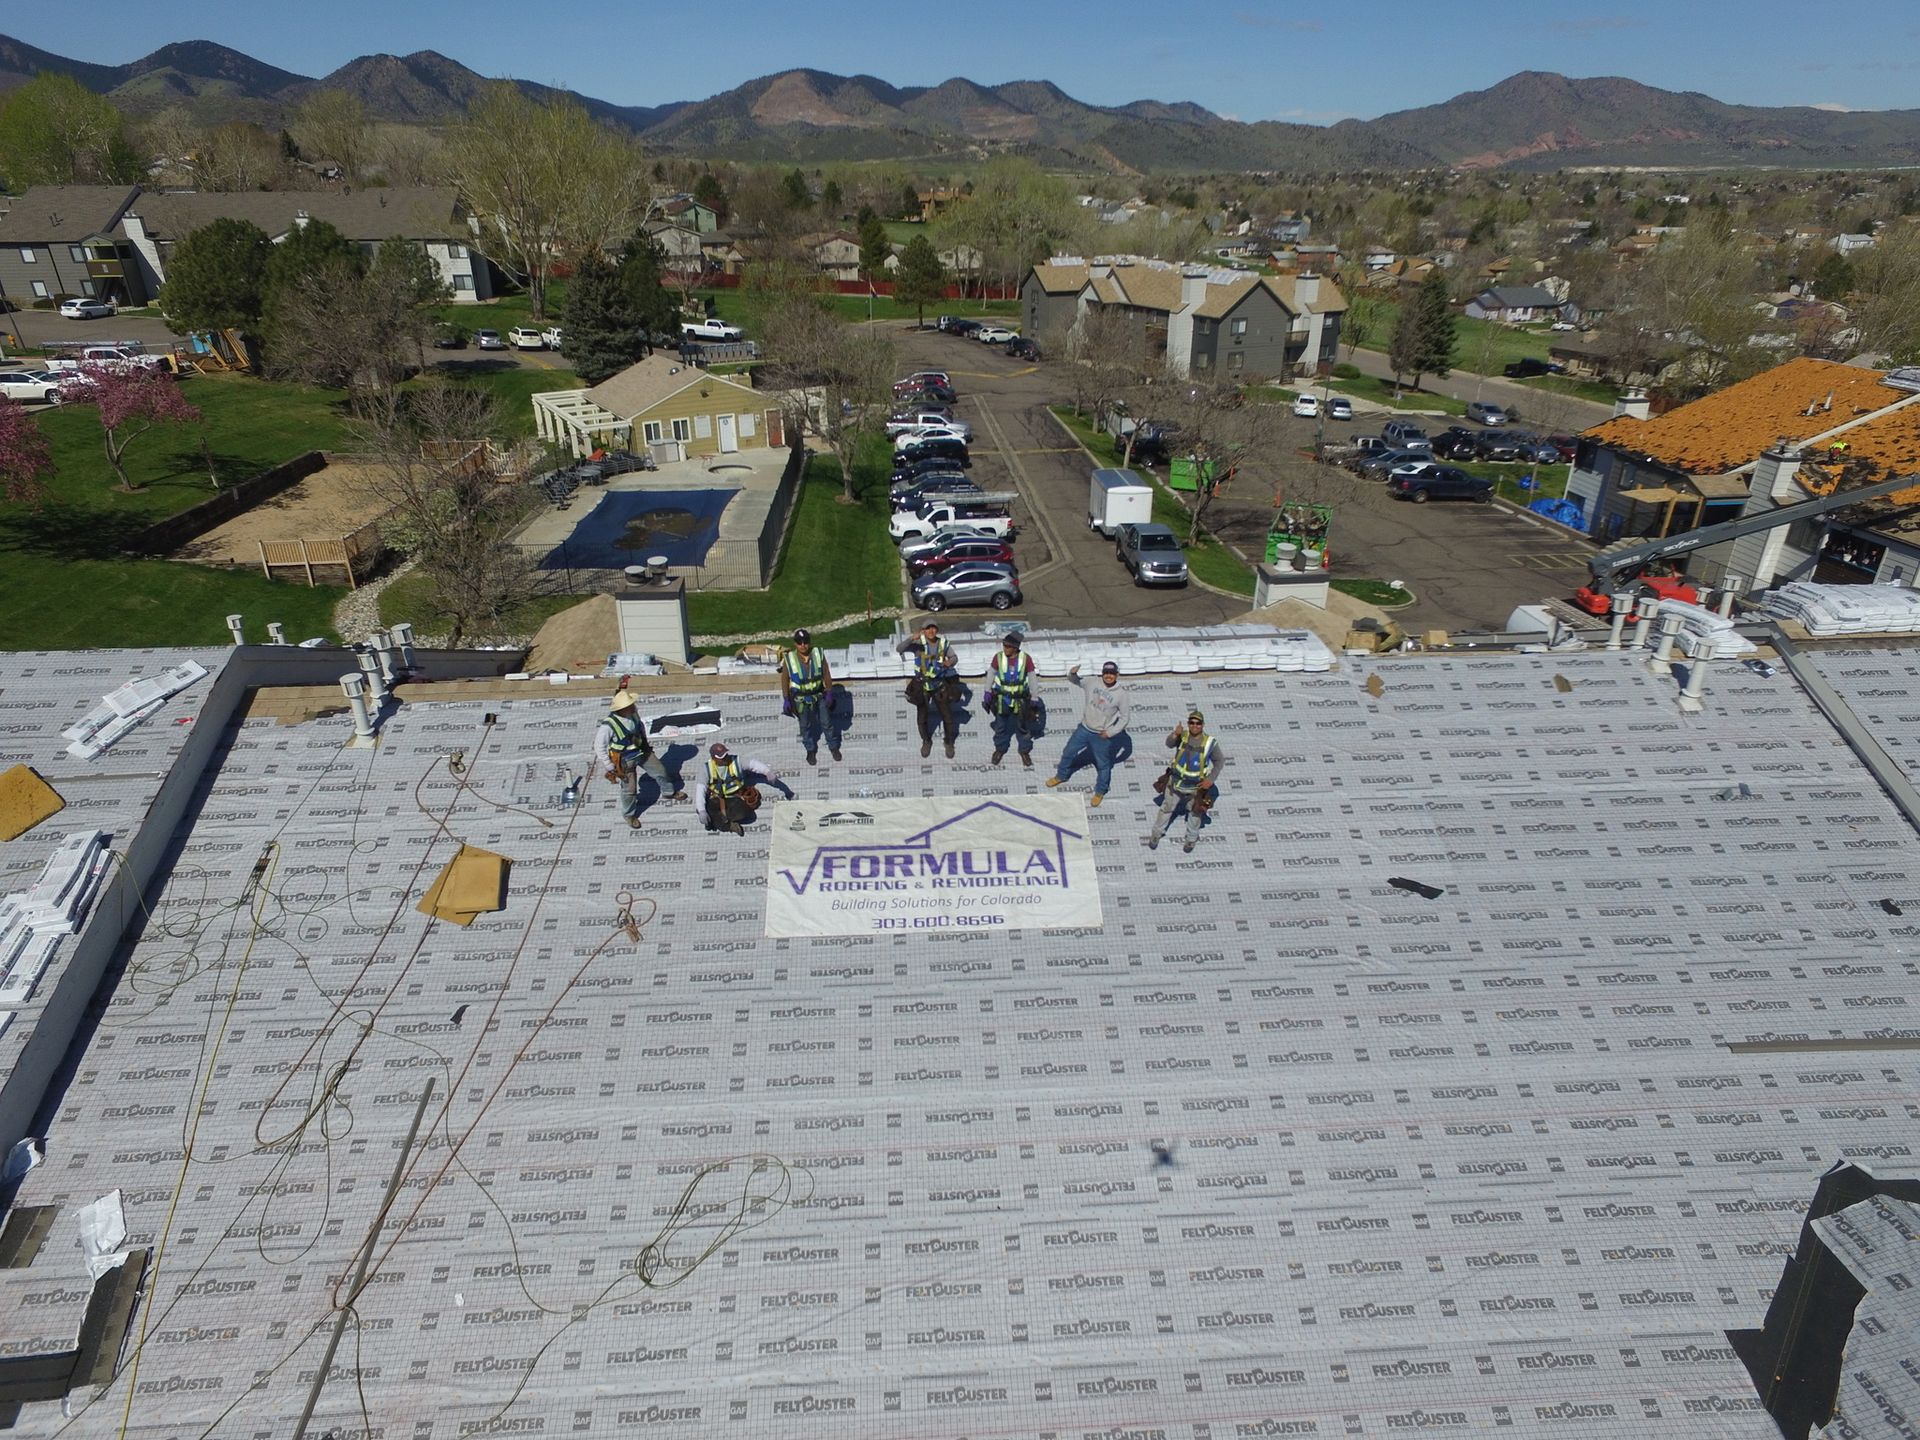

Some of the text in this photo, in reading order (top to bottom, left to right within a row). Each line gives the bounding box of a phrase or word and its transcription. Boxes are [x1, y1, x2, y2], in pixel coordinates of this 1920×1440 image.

[822, 850, 1056, 879] FORMULA
[820, 880, 907, 892] ROOFING
[932, 876, 1060, 888] REMODELING
[832, 894, 1042, 912] Building Solutions for Colorado
[872, 915, 1004, 929] 303.600.8696
